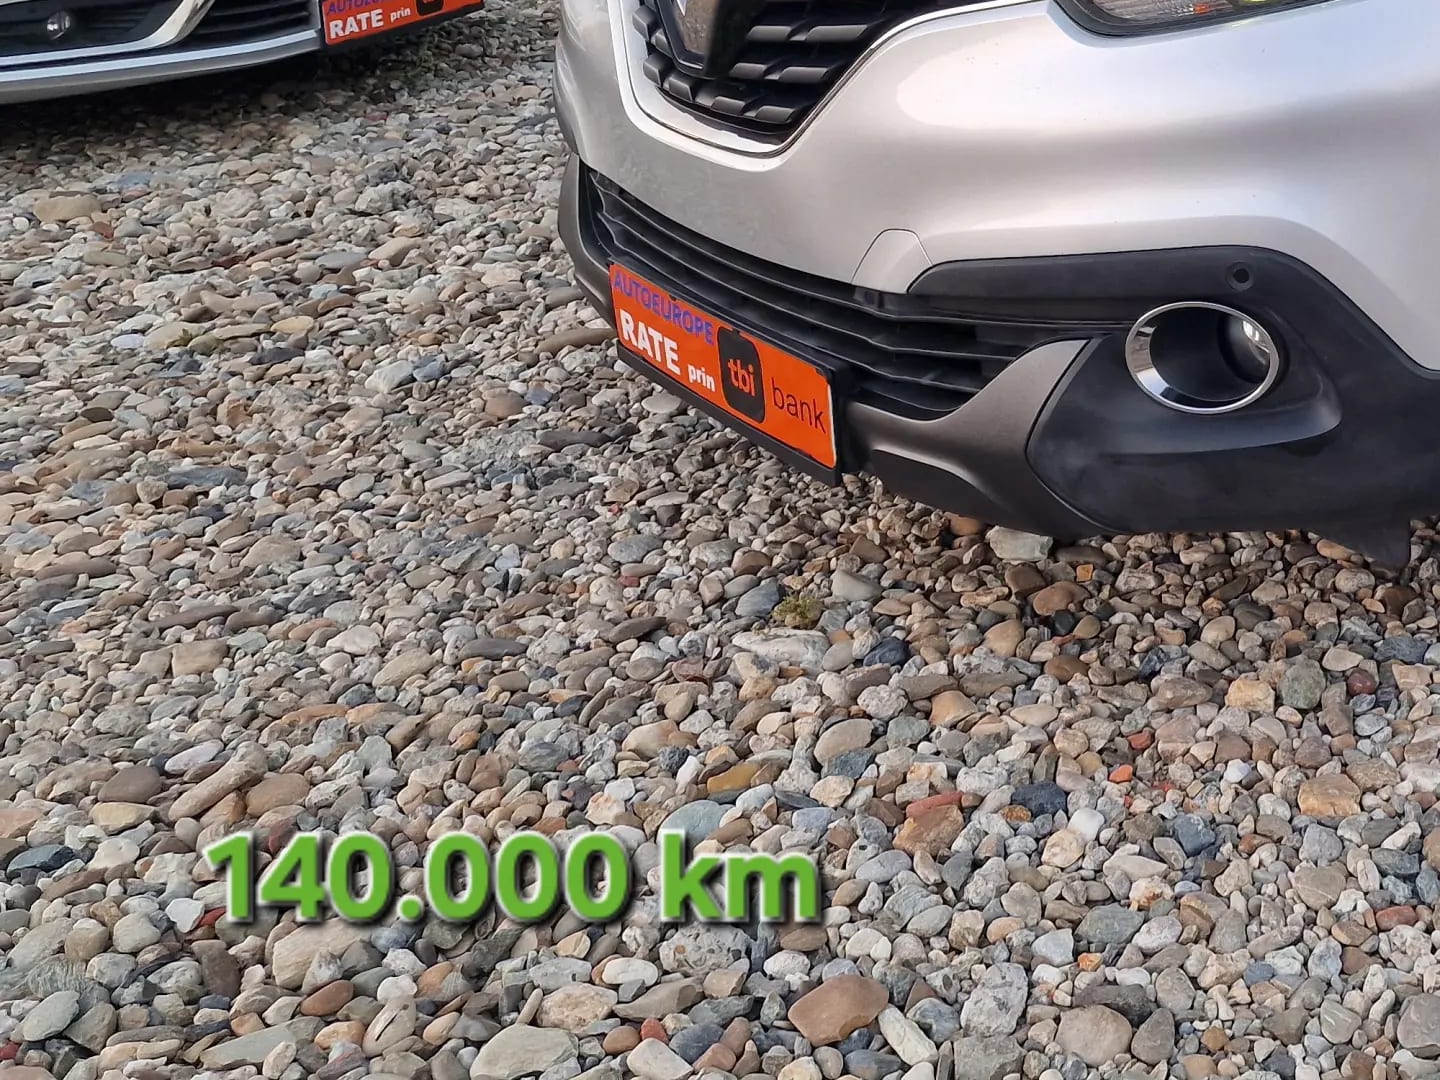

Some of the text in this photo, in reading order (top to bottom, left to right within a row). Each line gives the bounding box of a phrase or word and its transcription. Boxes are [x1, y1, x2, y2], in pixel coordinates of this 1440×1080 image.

[329, 8, 384, 39] RATE
[390, 7, 411, 23] prin
[613, 271, 715, 346] AUTOEUROPE
[619, 309, 827, 434] RATE prin tbi bank
